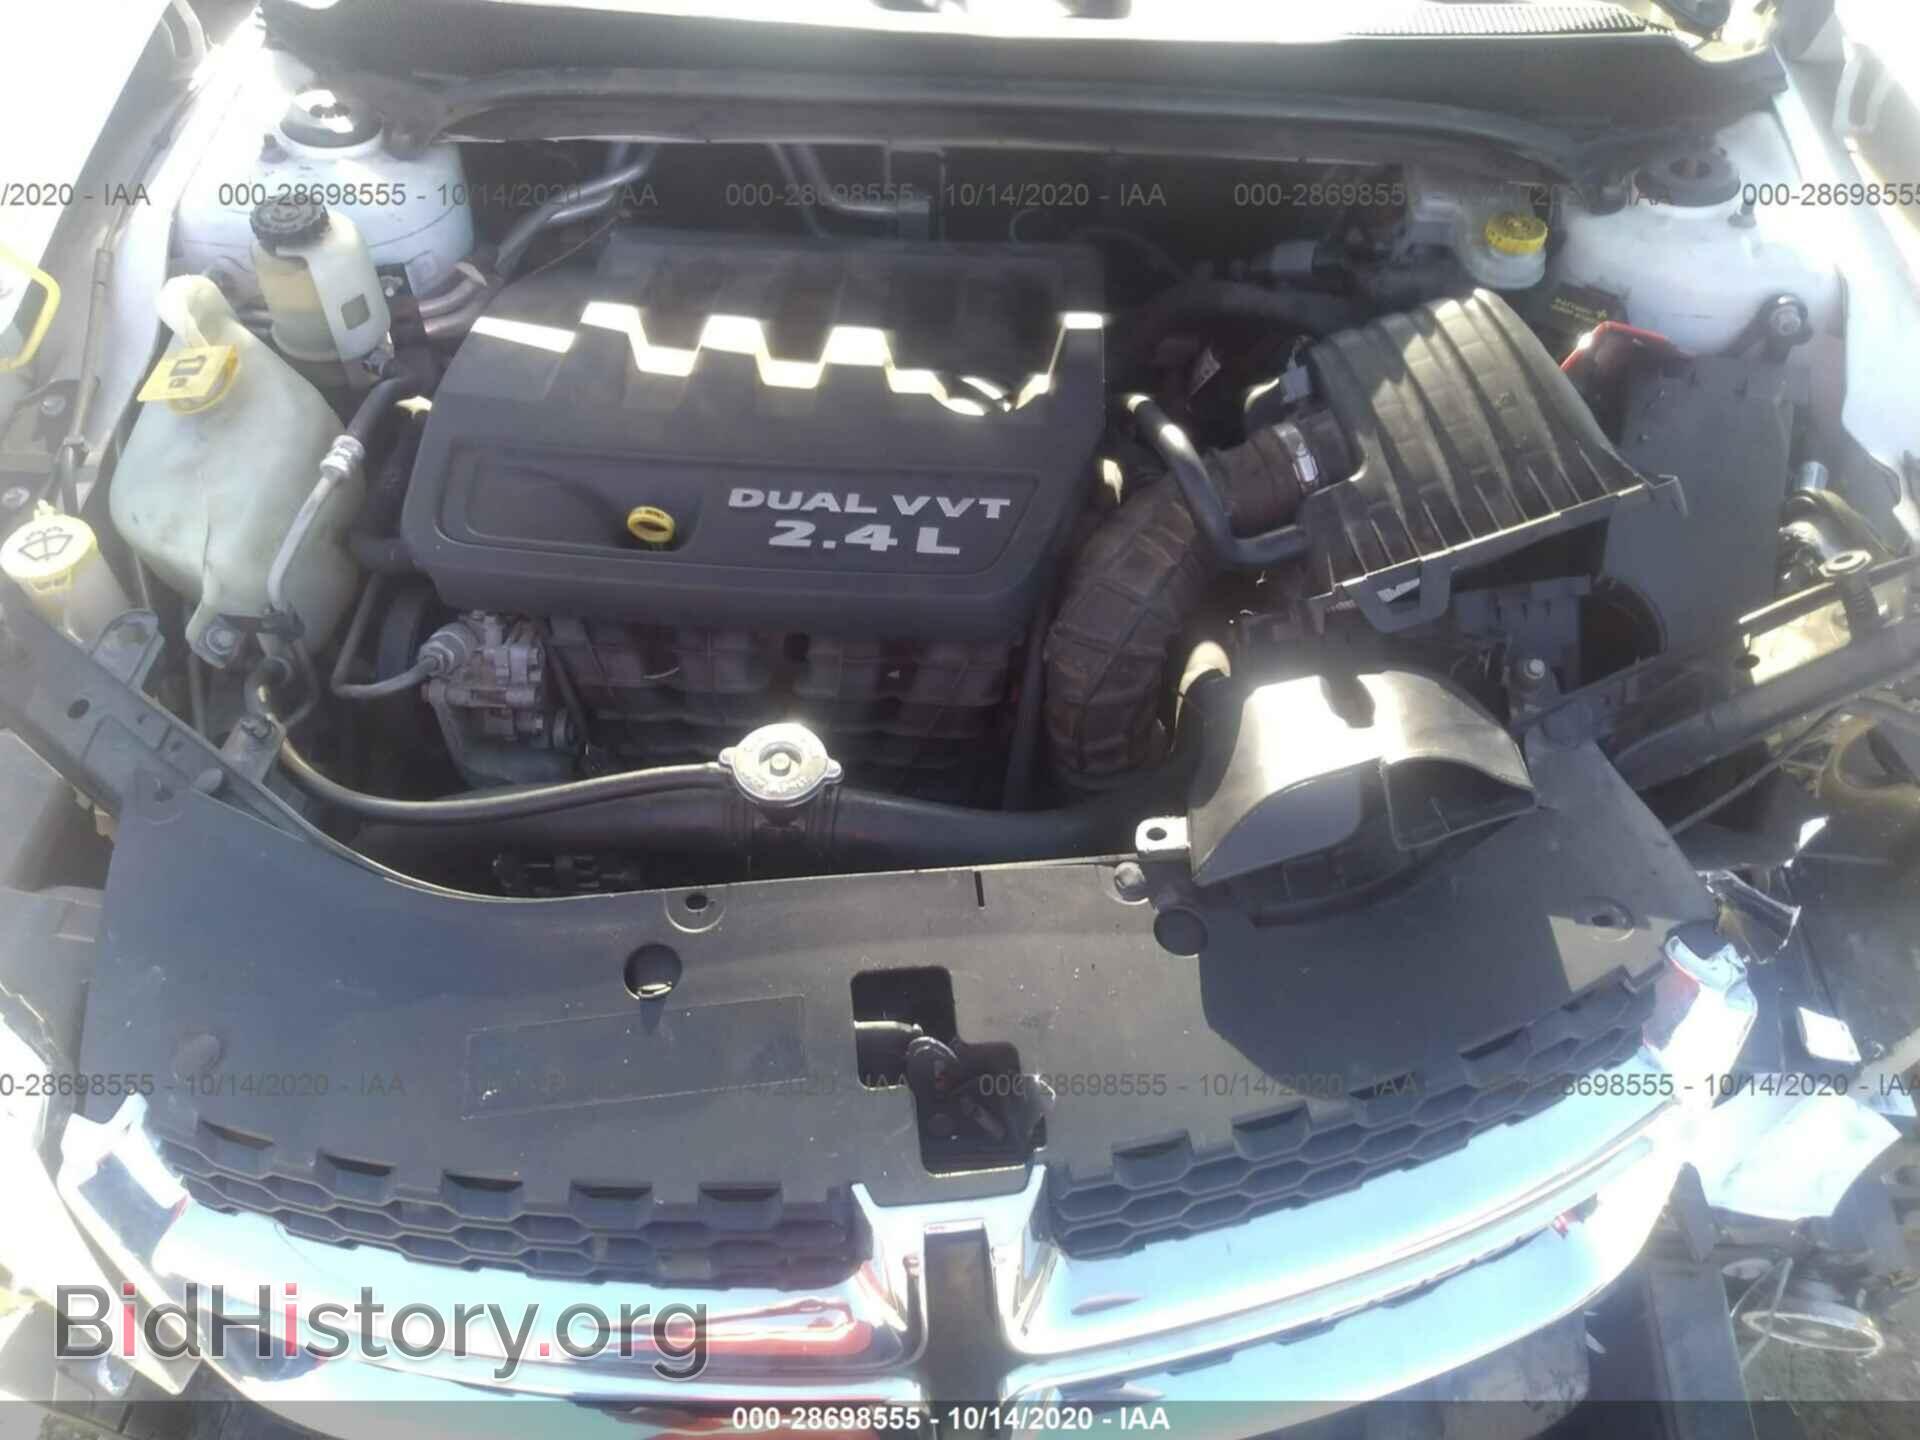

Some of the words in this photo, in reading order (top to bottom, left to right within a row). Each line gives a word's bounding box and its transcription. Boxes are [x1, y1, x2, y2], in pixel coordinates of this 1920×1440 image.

[728, 487, 878, 513] DUAL
[892, 494, 1011, 519] VVT
[768, 519, 898, 552] 2.4
[915, 526, 960, 555] L
